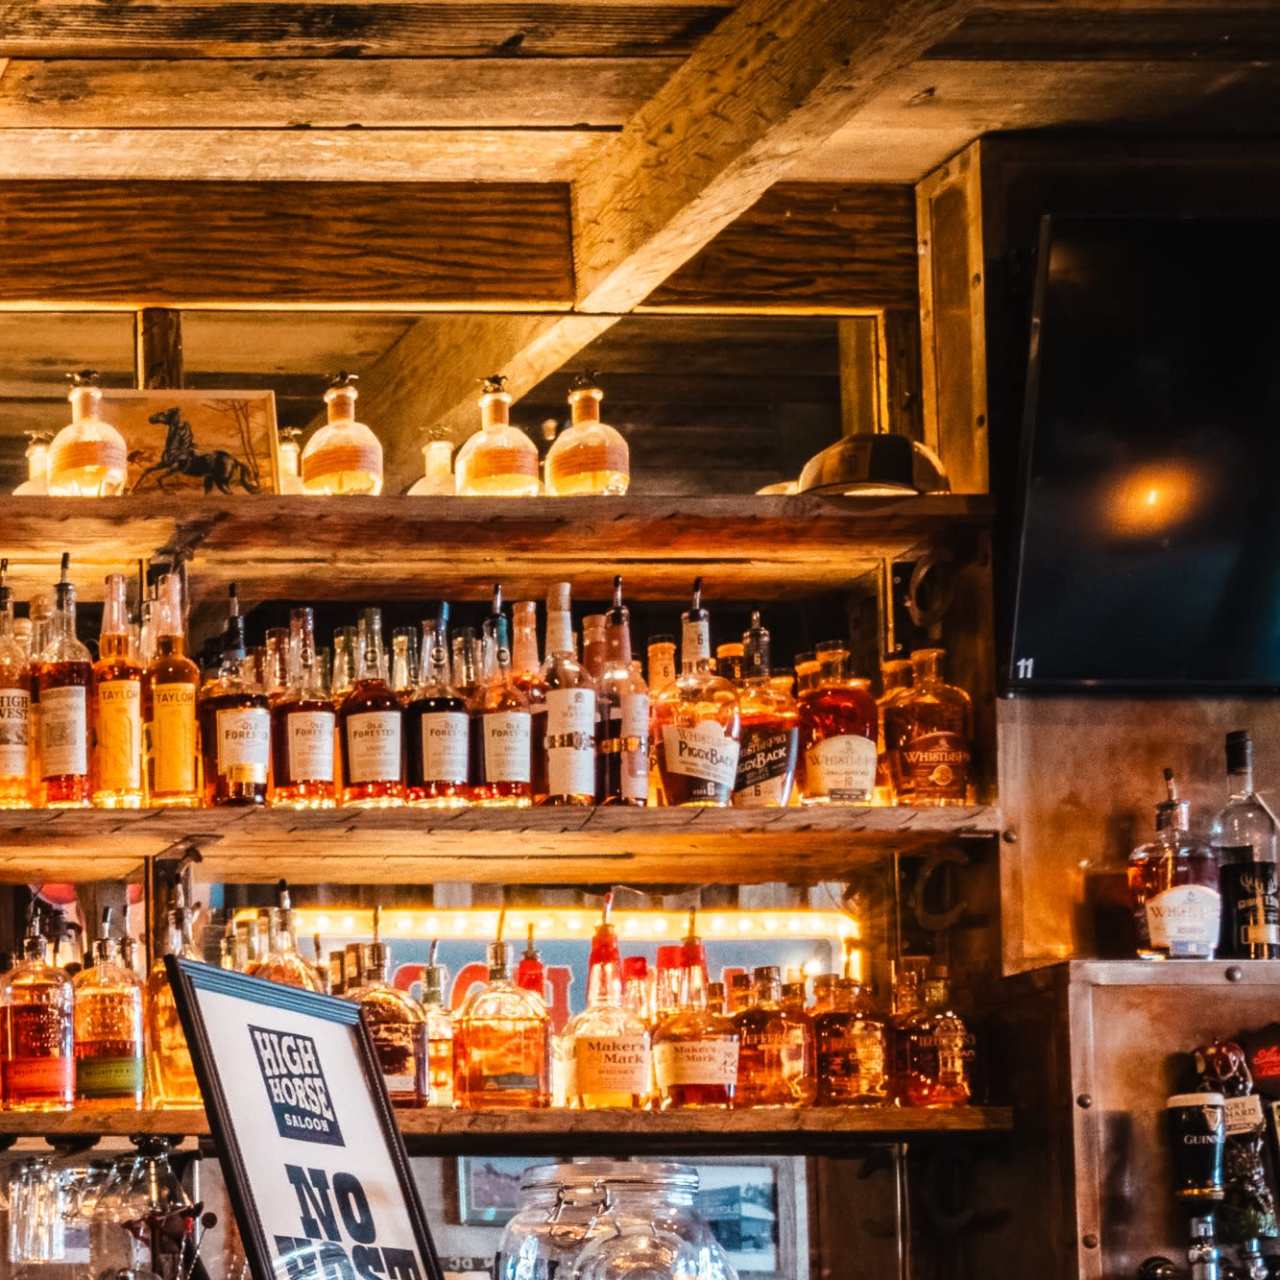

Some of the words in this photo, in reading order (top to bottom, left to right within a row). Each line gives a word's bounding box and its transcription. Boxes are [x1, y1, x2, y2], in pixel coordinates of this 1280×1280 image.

[678, 740, 734, 767] PIGGYBAC
[253, 1030, 320, 1076] HIGH
[603, 1054, 644, 1064] Mark
[268, 1077, 334, 1122] HORSE
[284, 1113, 330, 1132] SALOON
[284, 1163, 376, 1244] NO
